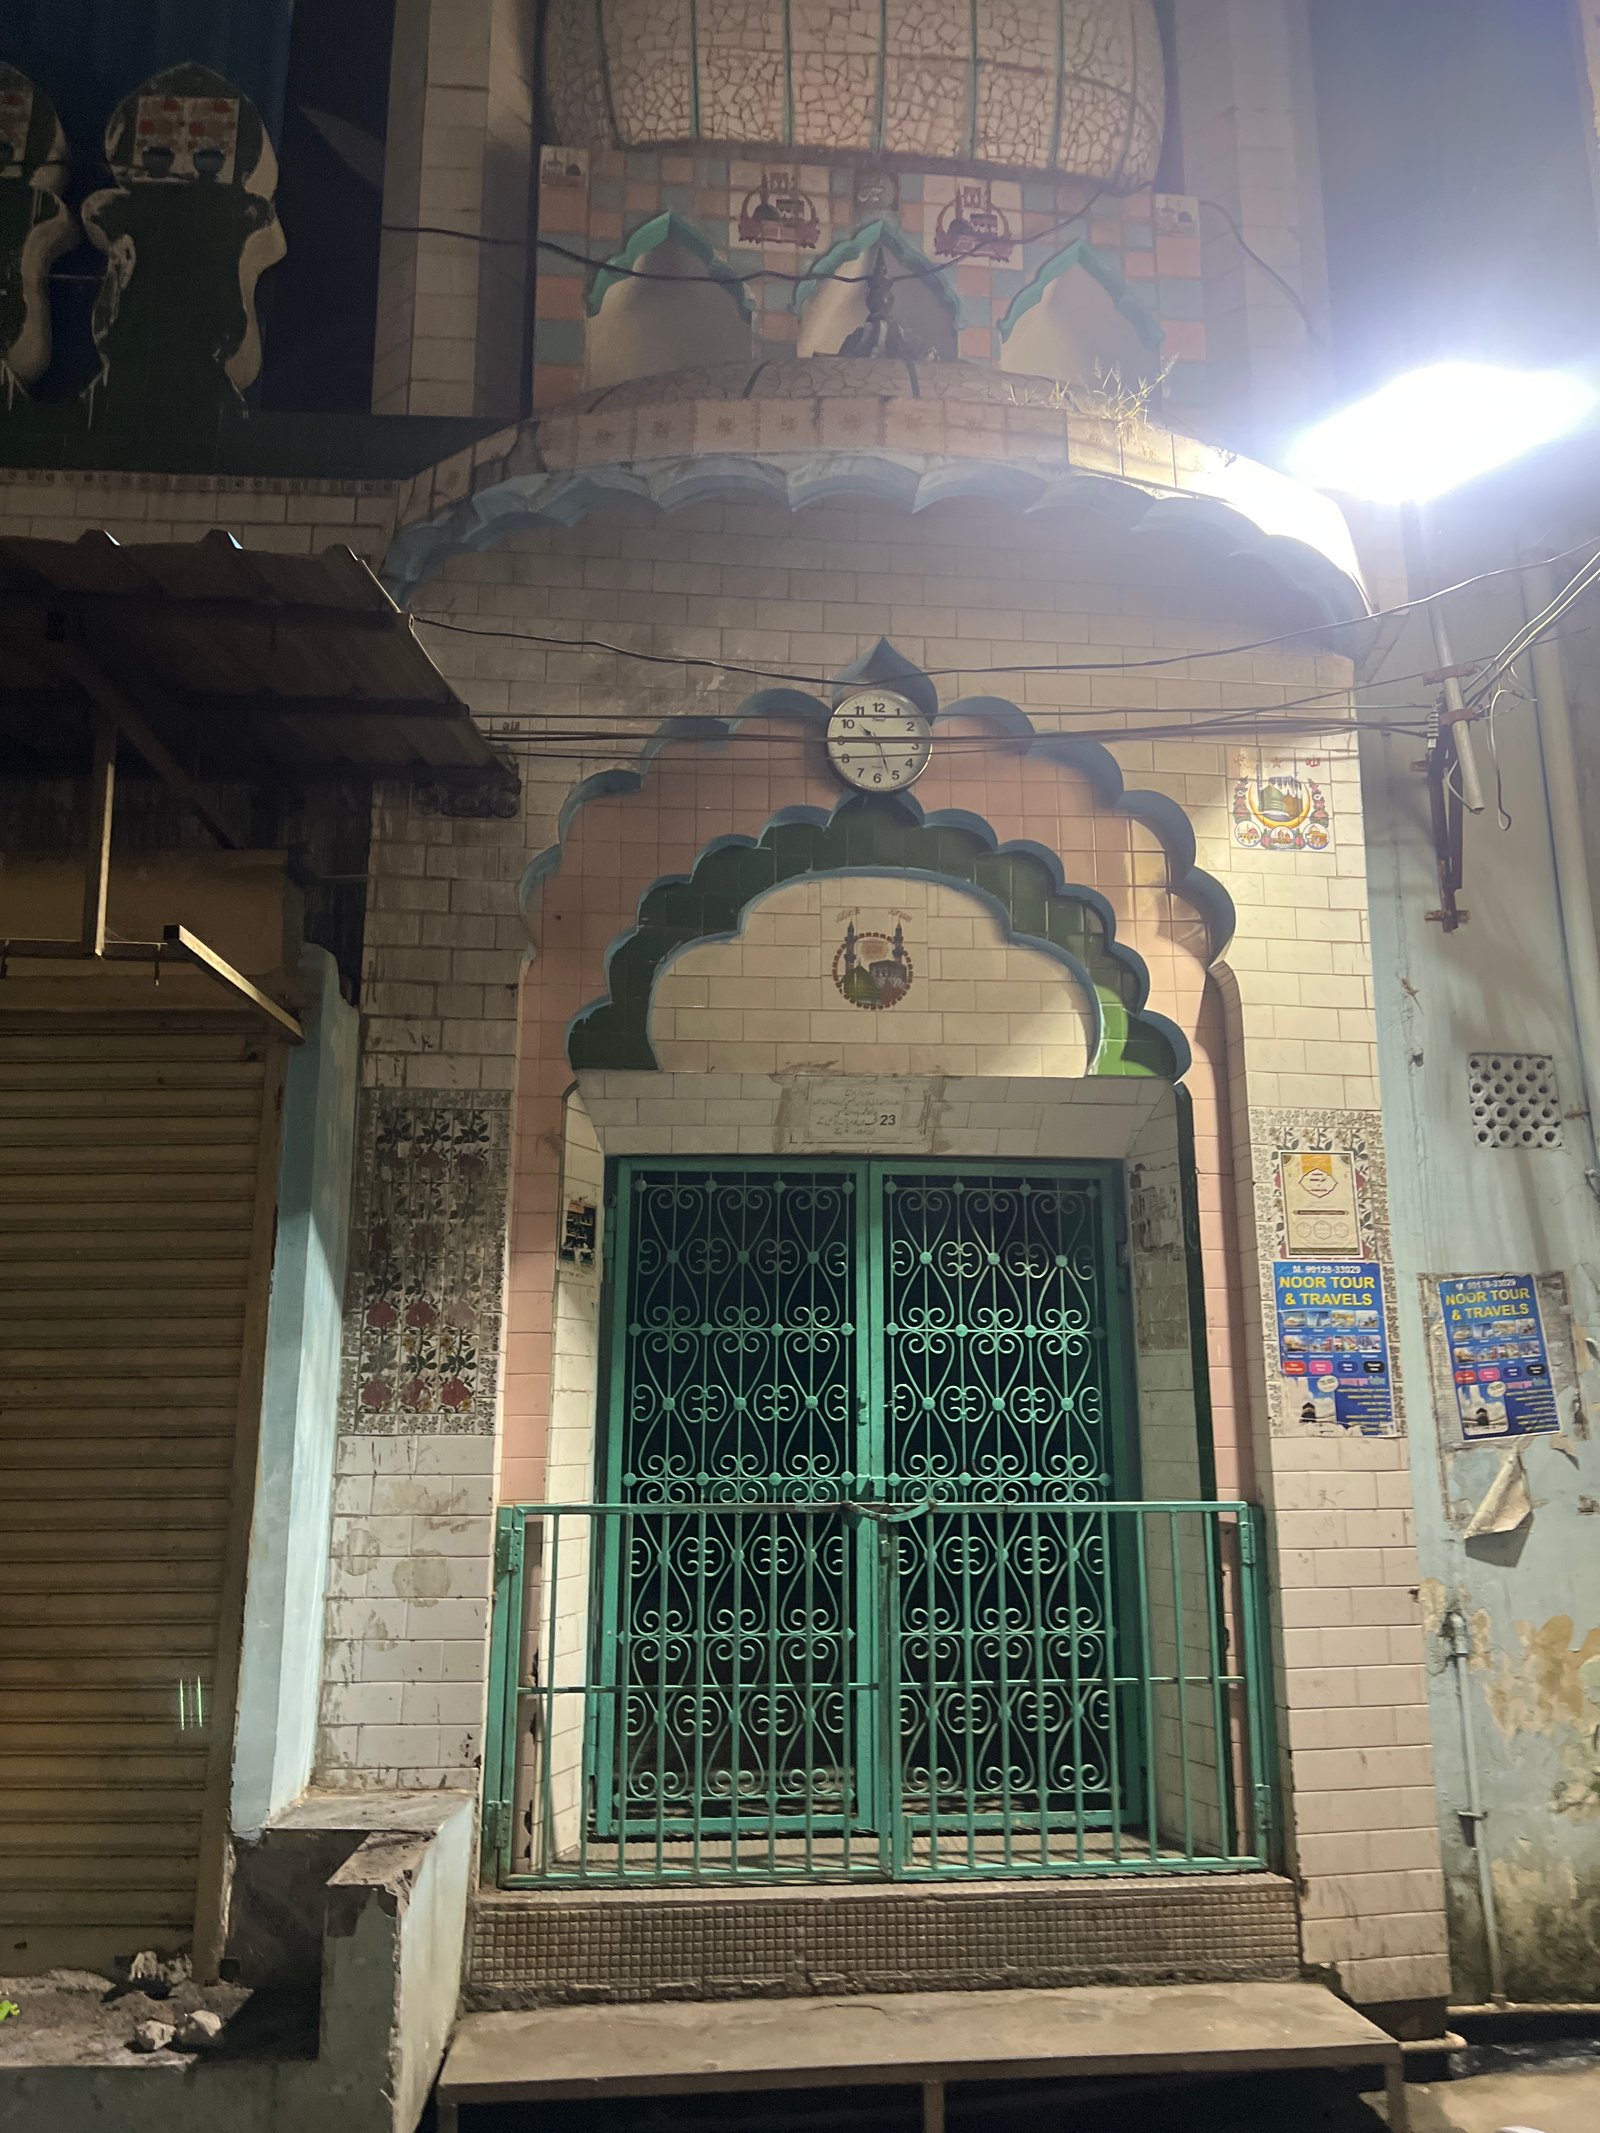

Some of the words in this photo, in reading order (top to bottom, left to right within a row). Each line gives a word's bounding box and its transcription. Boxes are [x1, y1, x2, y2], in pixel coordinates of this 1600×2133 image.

[854, 705, 865, 716] 11
[872, 702, 886, 713] 12
[895, 707, 901, 716] 1
[841, 719, 855, 729] 10
[906, 721, 915, 732] 2
[841, 753, 850, 764] 8
[904, 758, 914, 768] 4
[857, 768, 865, 778] 7
[873, 773, 882, 783] 6
[892, 770, 900, 780] 5
[879, 1114, 896, 1126] 23
[1279, 1276, 1327, 1289] NOOR
[1330, 1276, 1376, 1289] TOUR
[1284, 1292, 1296, 1306] &
[1300, 1293, 1373, 1306] TRAVELS
[1445, 1291, 1488, 1306] NOOR
[1490, 1287, 1531, 1301] TOUR
[1451, 1308, 1463, 1321] &
[1464, 1302, 1530, 1319] TRAVELS
